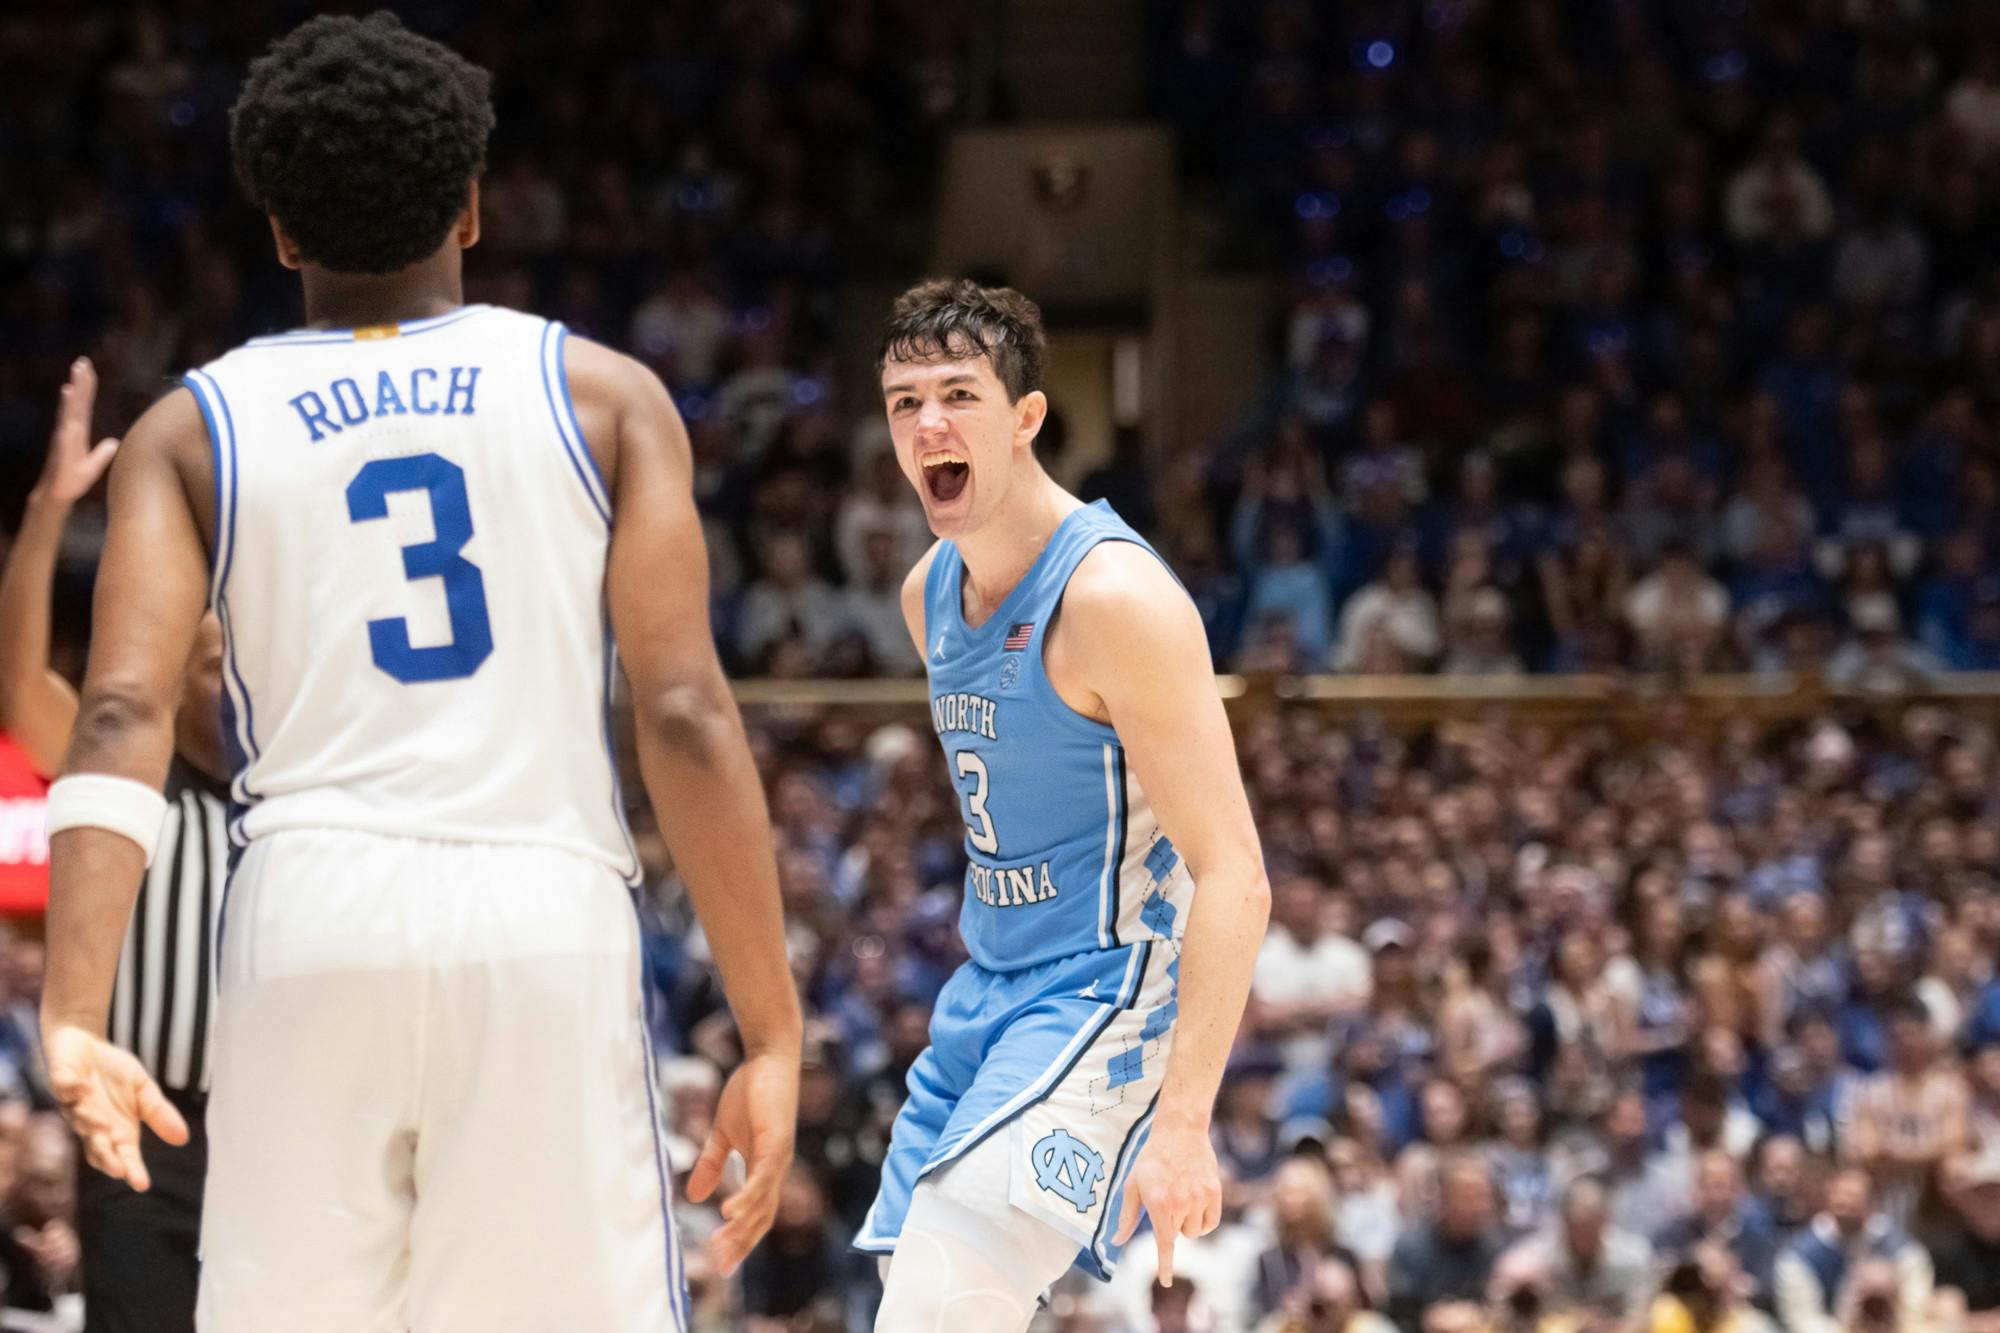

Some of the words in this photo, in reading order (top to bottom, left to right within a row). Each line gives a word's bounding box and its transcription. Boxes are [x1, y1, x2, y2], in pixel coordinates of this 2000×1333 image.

[288, 366, 481, 442] ROACH
[345, 453, 494, 685] 3
[935, 691, 998, 741] NORTH
[955, 750, 1000, 856] 3
